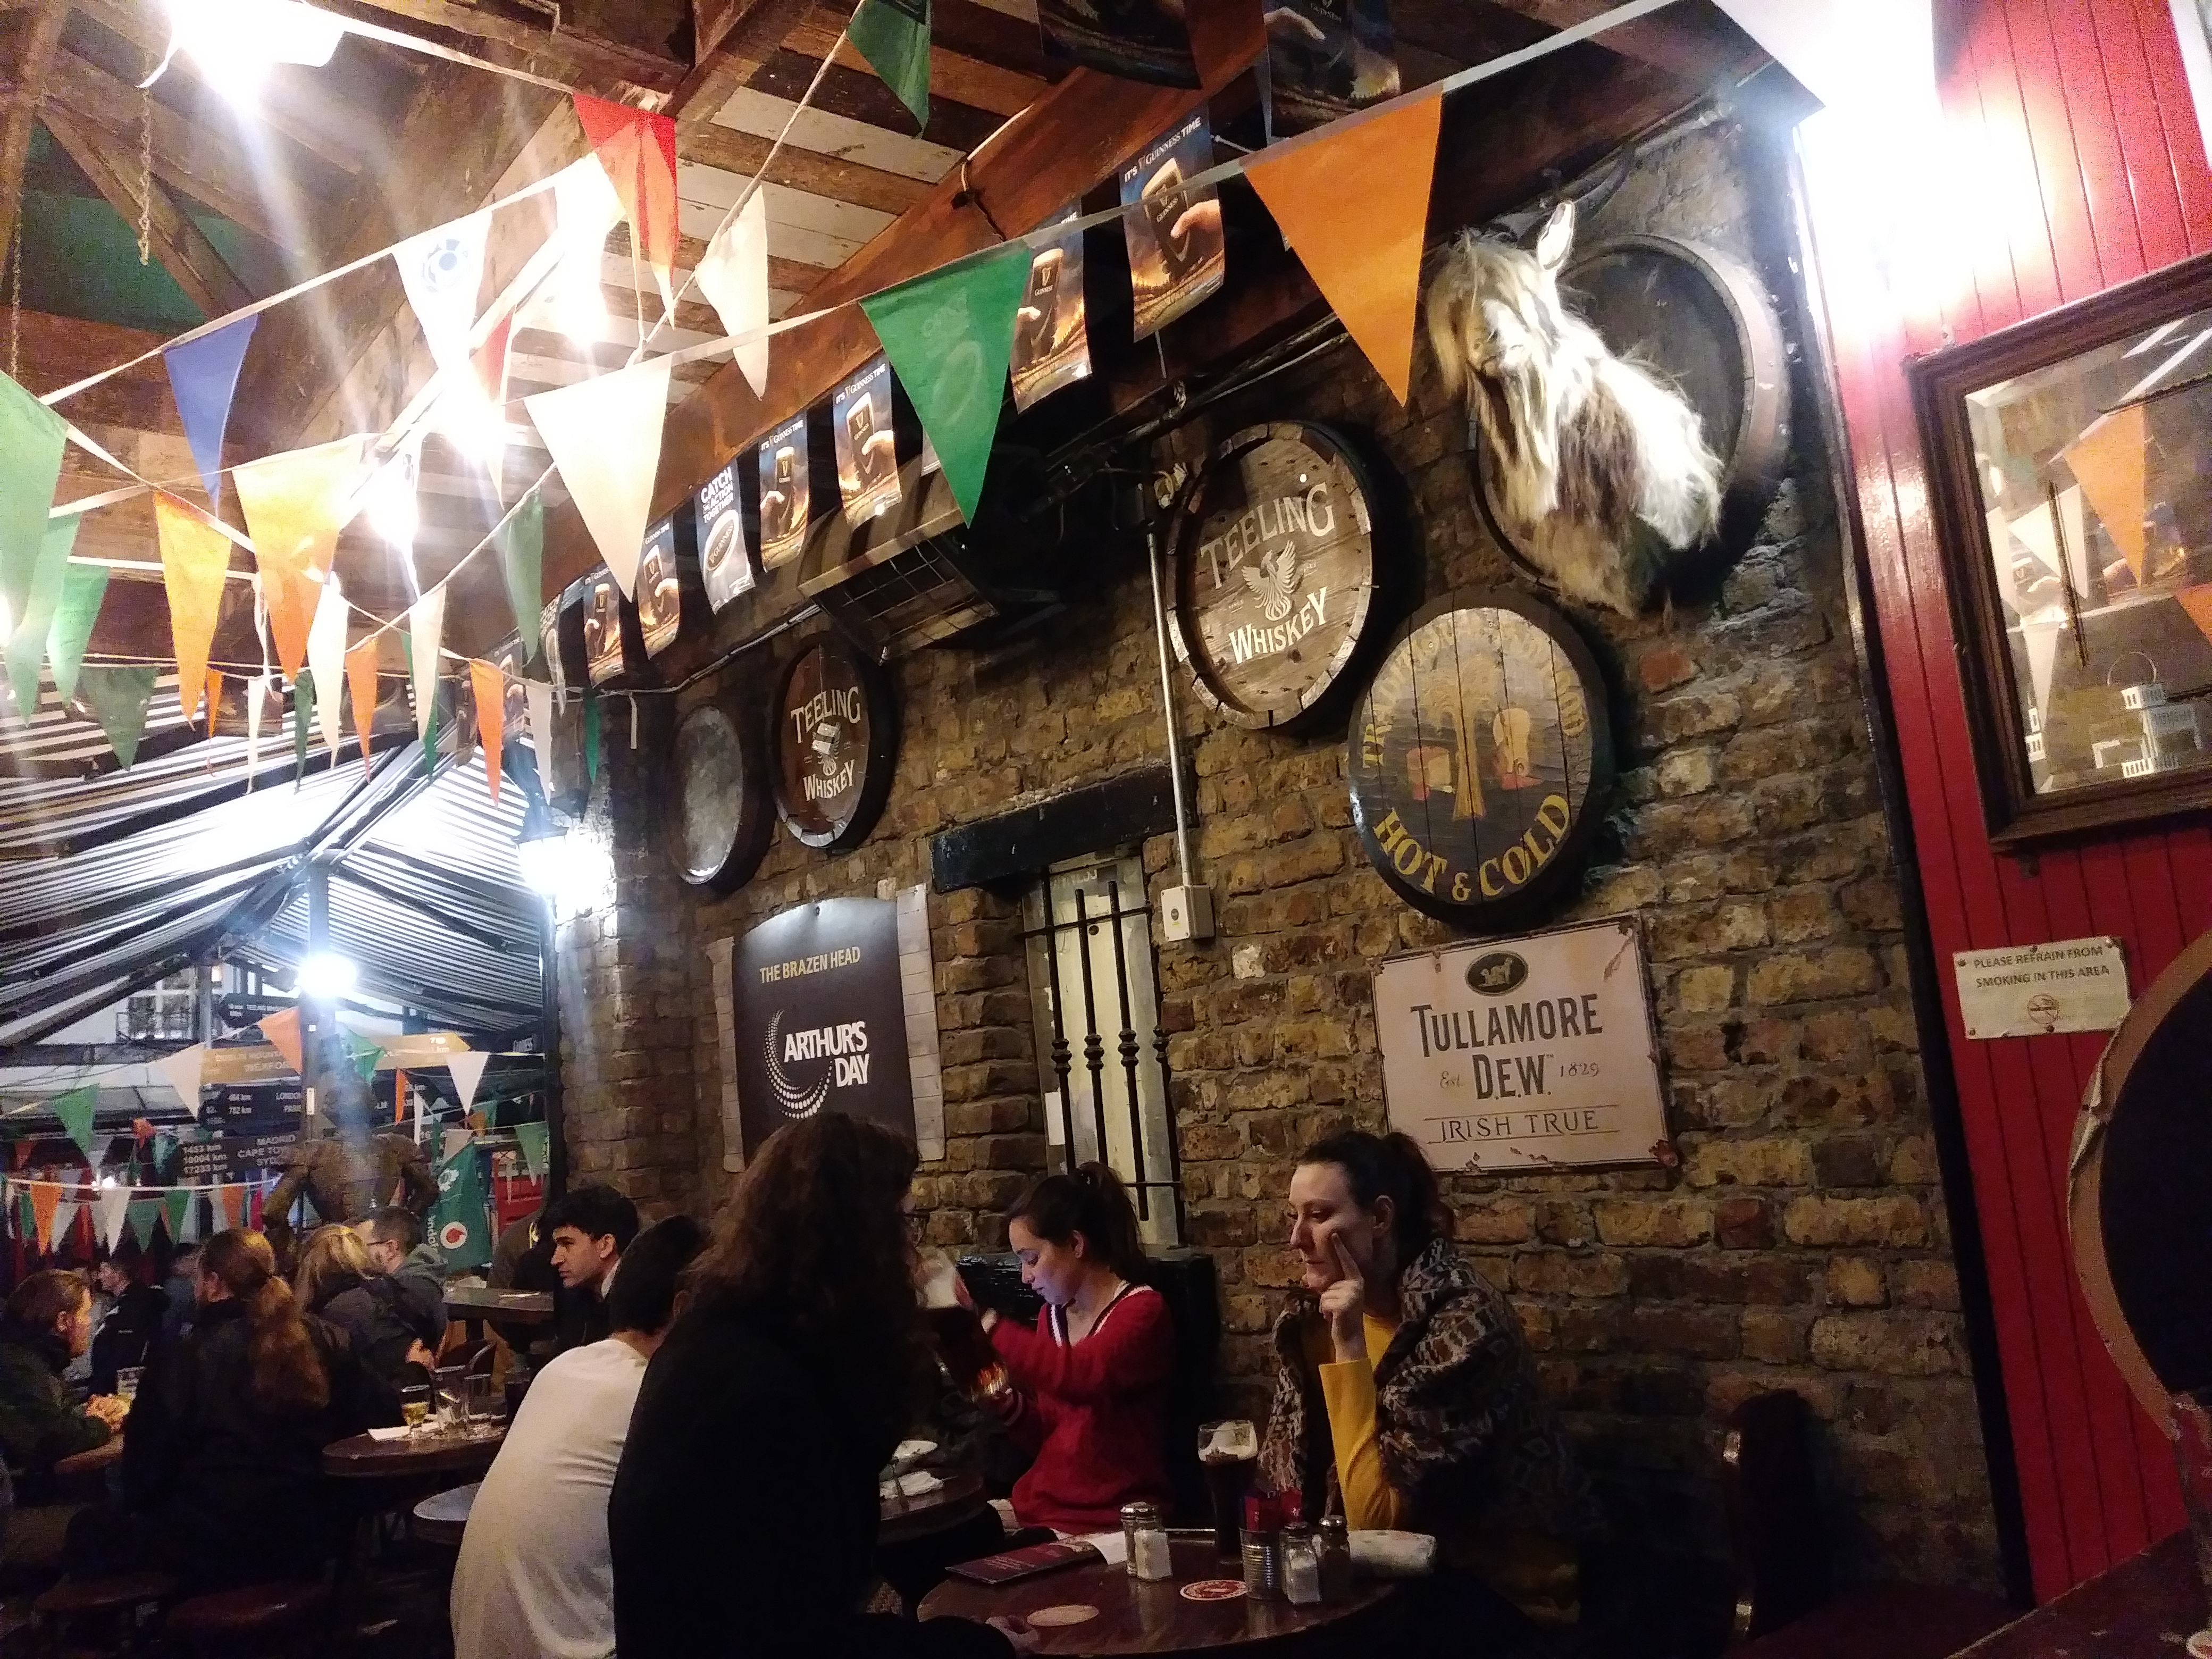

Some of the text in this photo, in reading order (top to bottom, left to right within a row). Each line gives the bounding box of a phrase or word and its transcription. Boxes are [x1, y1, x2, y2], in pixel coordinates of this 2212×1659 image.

[1124, 116, 1202, 182] IT'S GUINNESS TIME
[851, 373, 874, 394] GUINNESS
[701, 466, 733, 504] CATCH
[710, 481, 733, 509] ACTION
[703, 492, 734, 523] TOGETHER
[1200, 481, 1335, 590] TEELING
[1228, 586, 1328, 665] WHISKEY
[790, 686, 861, 744] TEELING
[803, 759, 855, 801] WHISKEY
[1373, 794, 1571, 901] HOT & COLD
[759, 946, 861, 984] THE BRAZEN HEAD
[1974, 946, 2103, 968] PLEASE REFRAIN FROM
[1975, 965, 2110, 988] SMOKING IN THIS AREA
[784, 1021, 868, 1063] ARTHUR'S
[1410, 993, 1603, 1058] TULLAMORE
[834, 1053, 870, 1087] DAY
[1559, 1062, 1600, 1077] 1829
[1441, 1110, 1598, 1142] IRISH TRUE
[206, 1143, 222, 1152] km
[238, 1147, 265, 1158] CAPE
